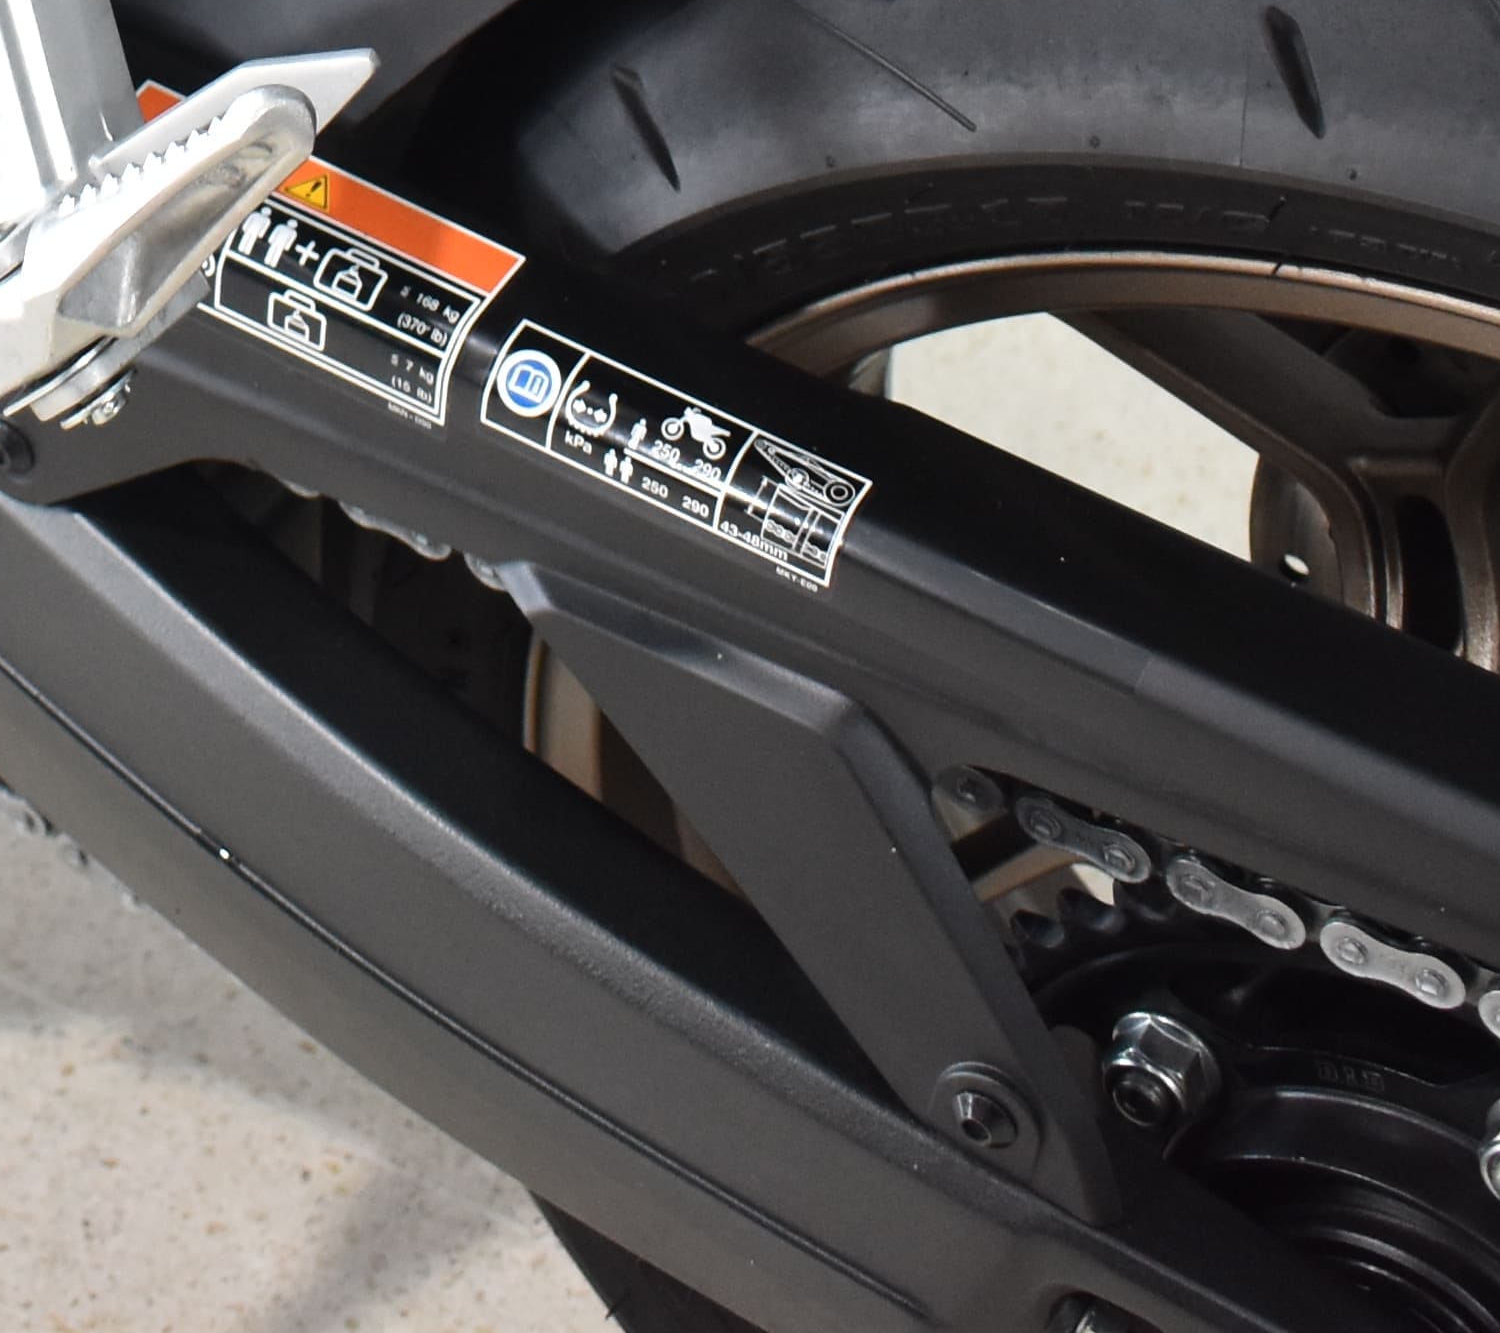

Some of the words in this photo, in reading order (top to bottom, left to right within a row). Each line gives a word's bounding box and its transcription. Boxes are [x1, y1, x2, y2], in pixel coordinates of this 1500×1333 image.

[442, 304, 460, 325] kg
[419, 366, 434, 386] kg
[564, 430, 593, 455] kPa
[654, 440, 681, 463] 250
[695, 458, 722, 482] 290
[641, 476, 669, 500] 250
[682, 495, 710, 519] 290
[720, 520, 788, 562] 43-48mm
